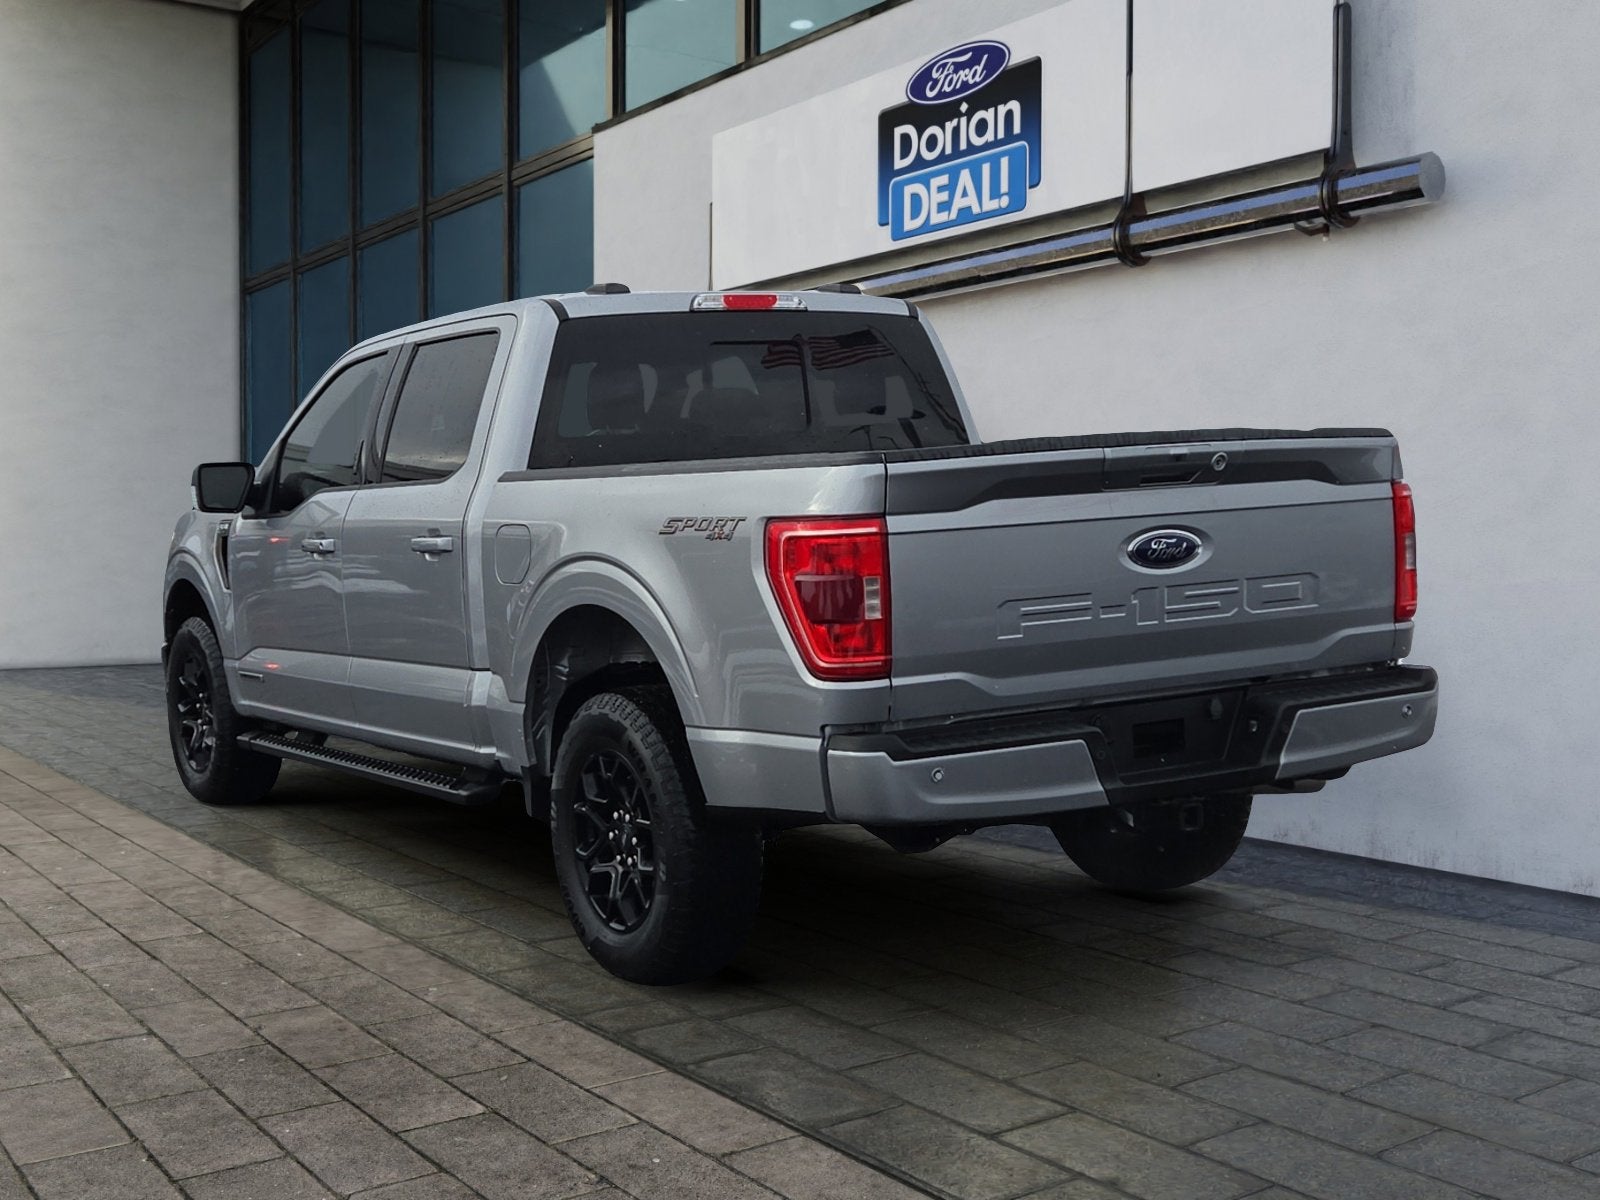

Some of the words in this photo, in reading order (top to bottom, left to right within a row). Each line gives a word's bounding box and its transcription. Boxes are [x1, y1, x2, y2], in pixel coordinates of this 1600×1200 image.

[925, 51, 989, 98] Ford
[893, 100, 1022, 171] Dorian
[903, 156, 1010, 232] DEAL!
[658, 517, 747, 535] SPORT
[1147, 538, 1188, 560] Ford
[997, 572, 1320, 640] F-150
